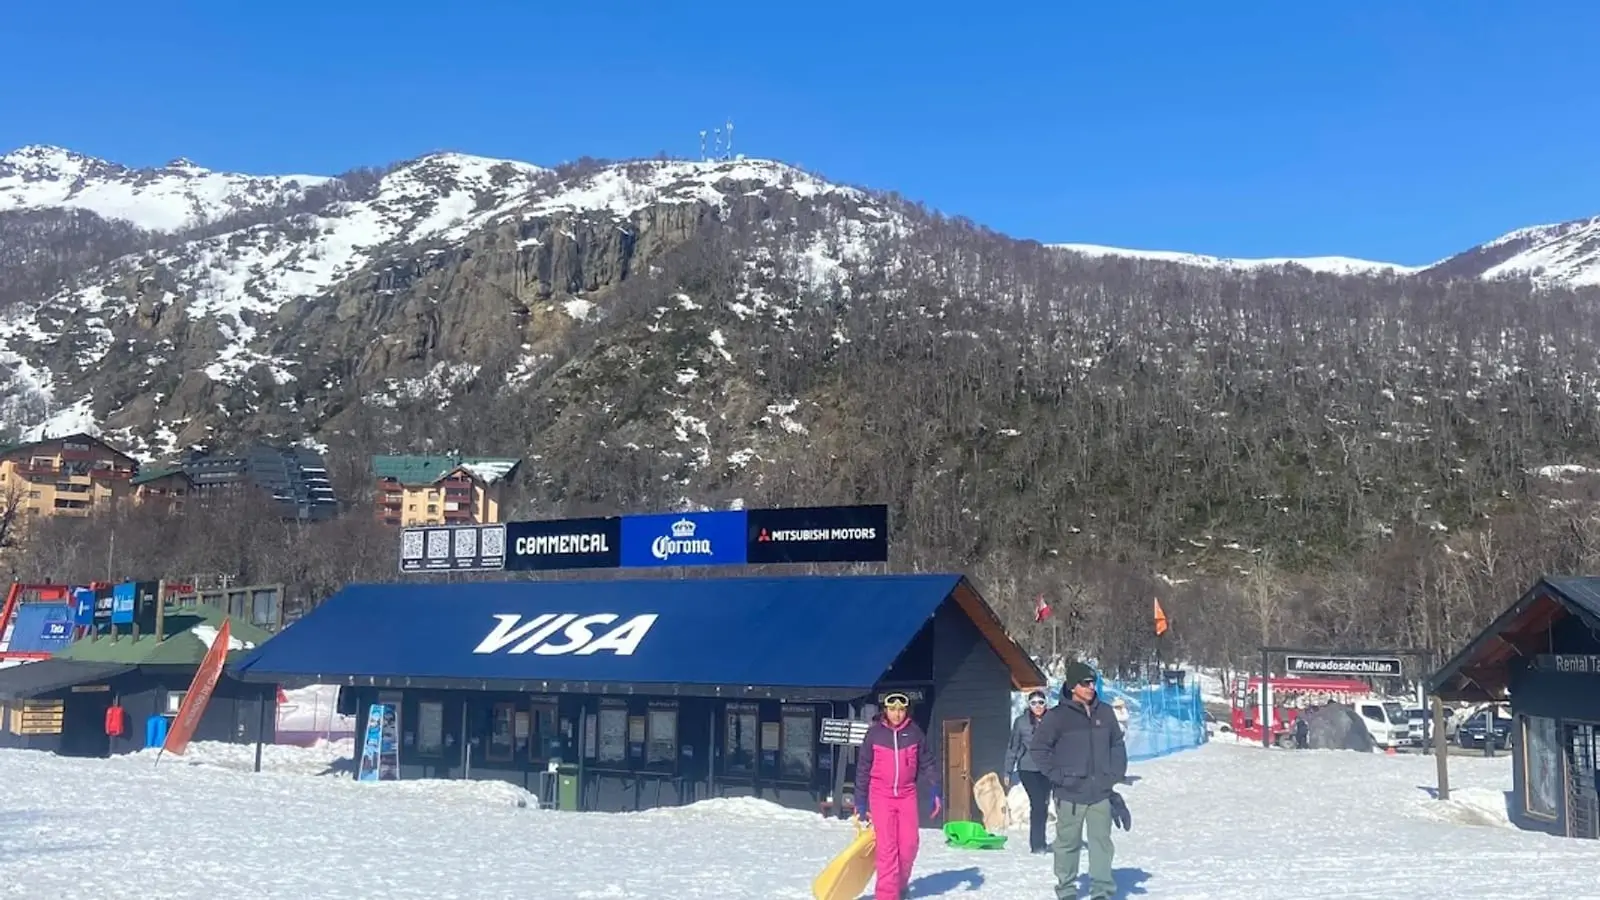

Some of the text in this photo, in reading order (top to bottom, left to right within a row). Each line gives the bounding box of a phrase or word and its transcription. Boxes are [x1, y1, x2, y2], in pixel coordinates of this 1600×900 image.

[771, 528, 876, 541] MITSUBISHI MOTORS
[516, 534, 609, 555] COMMENCAL
[652, 535, 713, 560] Corona
[472, 614, 658, 655] VISA
[1295, 660, 1392, 672] #nevadosdechillan
[1556, 655, 1588, 672] Rental
